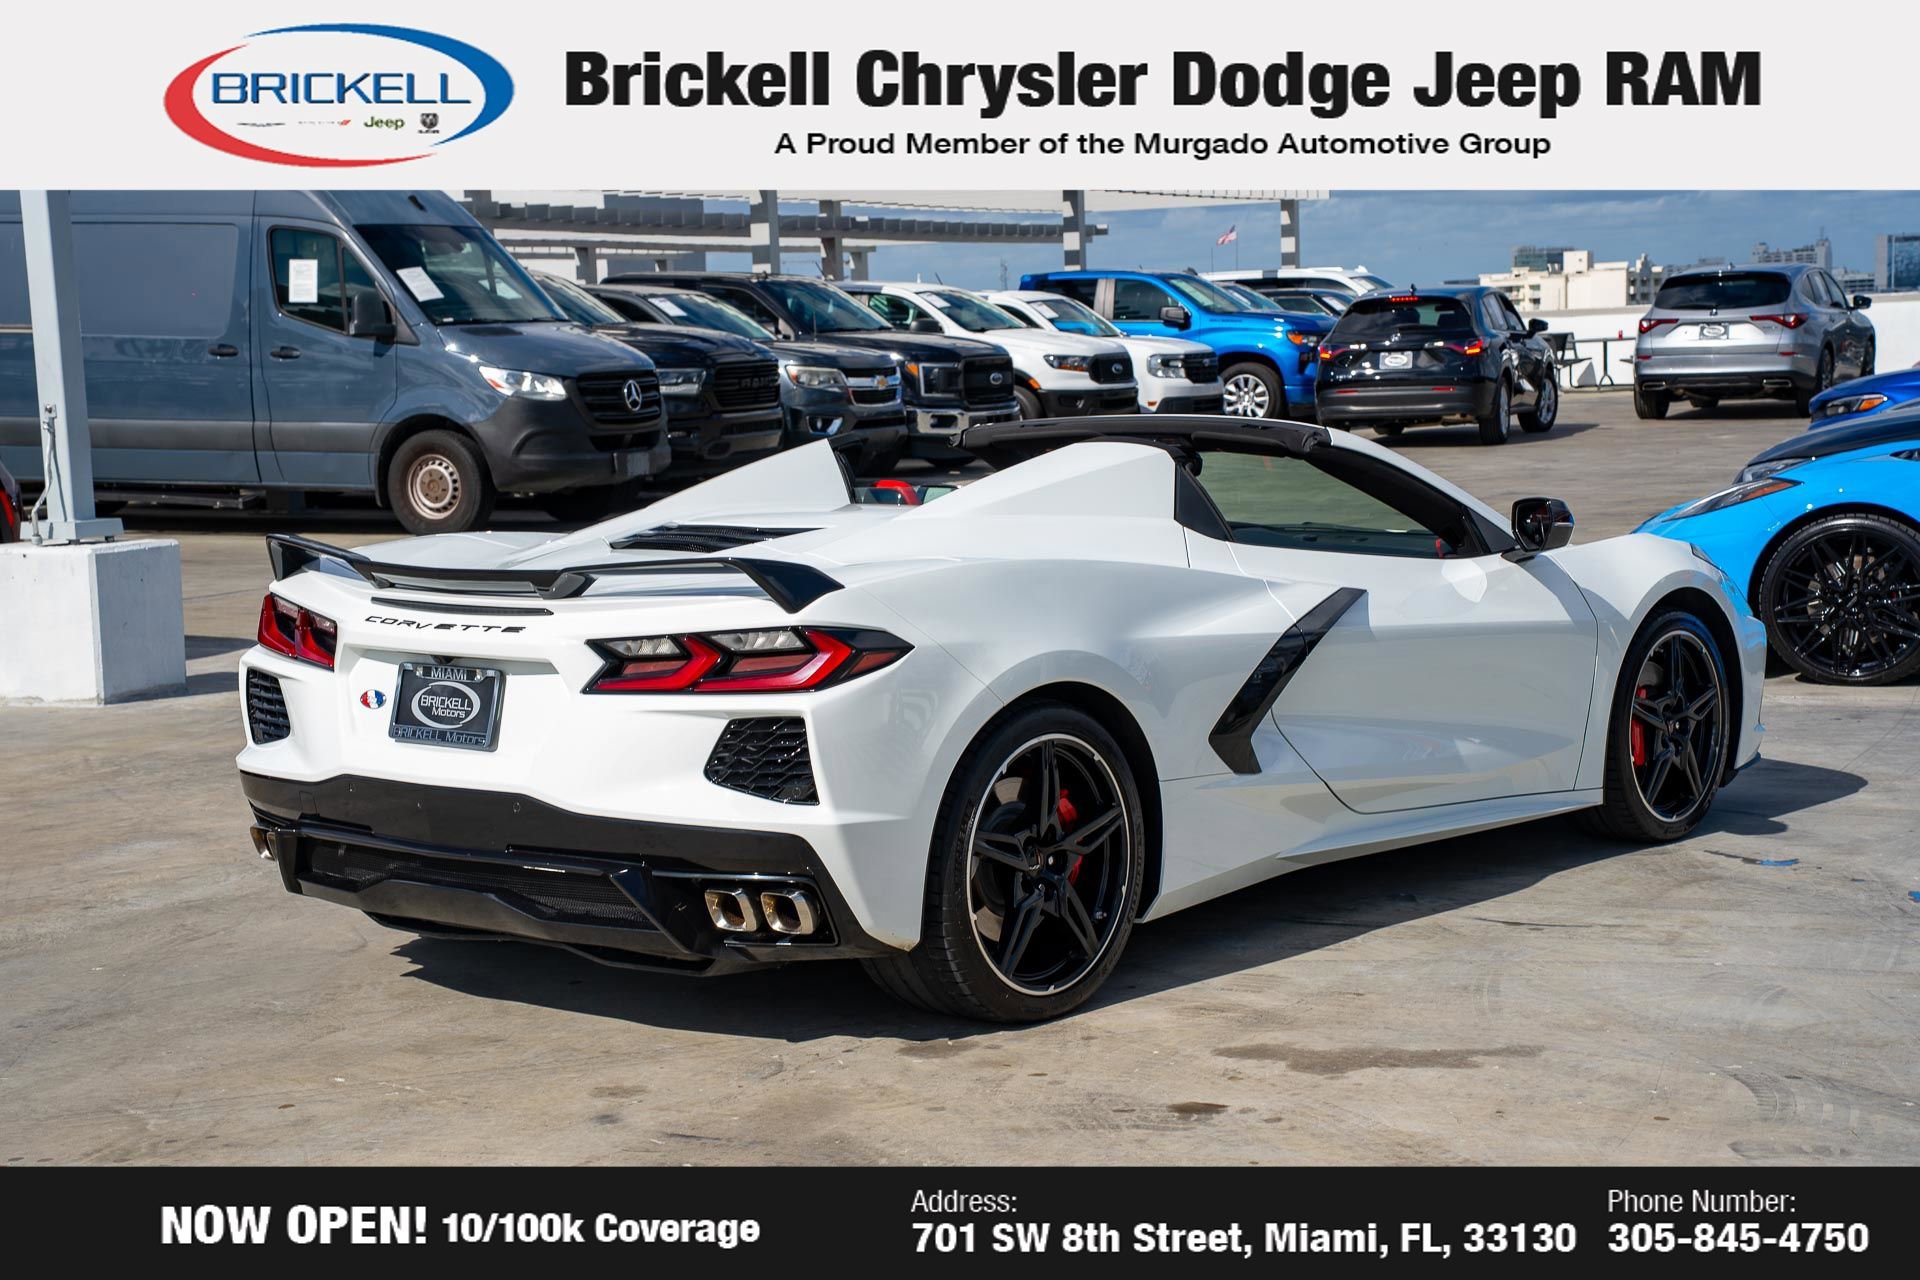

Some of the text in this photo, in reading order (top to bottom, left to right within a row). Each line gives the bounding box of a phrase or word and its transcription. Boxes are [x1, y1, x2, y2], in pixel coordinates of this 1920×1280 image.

[365, 615, 527, 634] CORVETTE
[430, 667, 468, 682] MIAMI
[420, 694, 472, 712] BRICKELL
[431, 706, 466, 719] Motors
[393, 726, 486, 745] BRICKELL Motors
